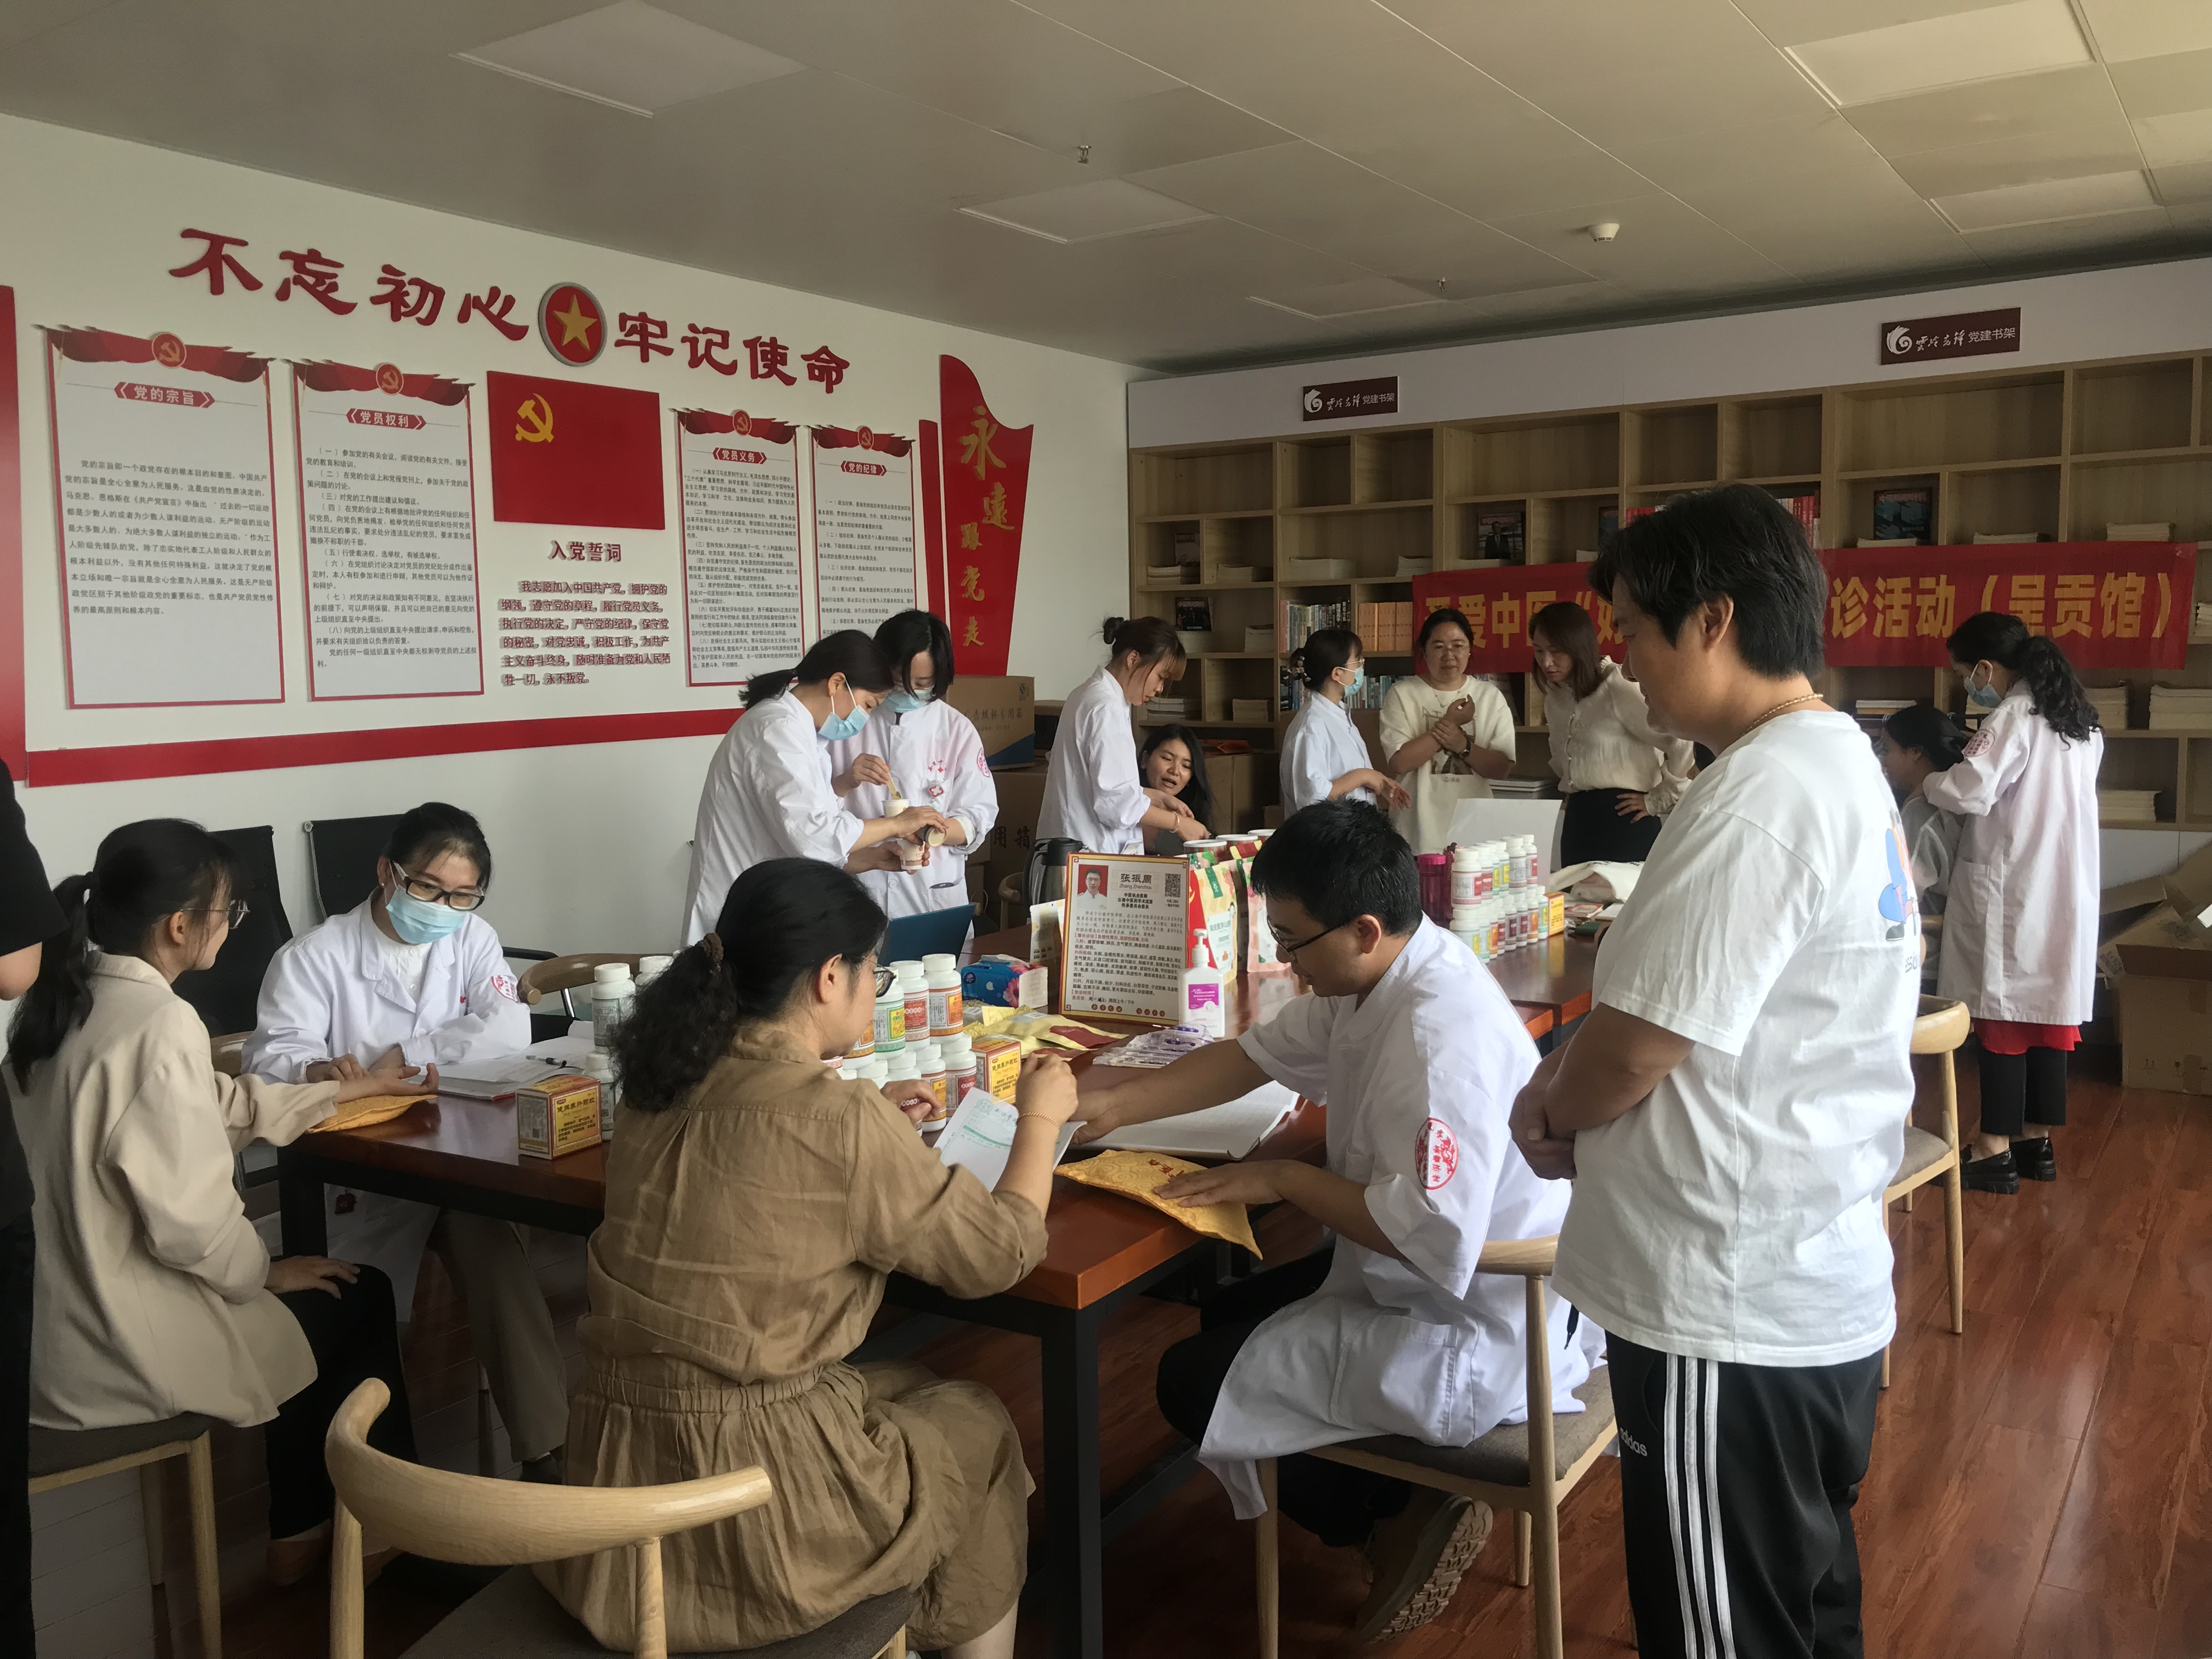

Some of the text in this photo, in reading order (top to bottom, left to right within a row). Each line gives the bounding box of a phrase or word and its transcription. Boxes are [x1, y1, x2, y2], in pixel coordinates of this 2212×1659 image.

[168, 228, 850, 394] 不忘初心 牢记使命
[134, 385, 195, 406] 党的宗旨
[360, 411, 409, 427] 党员权利
[722, 449, 755, 462] 党员义务
[849, 462, 877, 475] 党的纪律
[551, 540, 622, 562] 入党誓词
[521, 581, 668, 595] 我志愿加入中国共产党，拥护党的
[1831, 572, 2172, 639] 诊活动（呈贡馆）
[503, 618, 669, 630] 执行党的决定，严守党的纪律，保守党
[503, 636, 669, 648] 的秘密，对党忠诚，积极工作，为共产
[504, 653, 670, 666] 主义奋斗终身，随时准备为党和人民牺
[505, 673, 589, 685] 牲一切，永不叛党。
[1620, 1427, 1647, 1457] adidas
